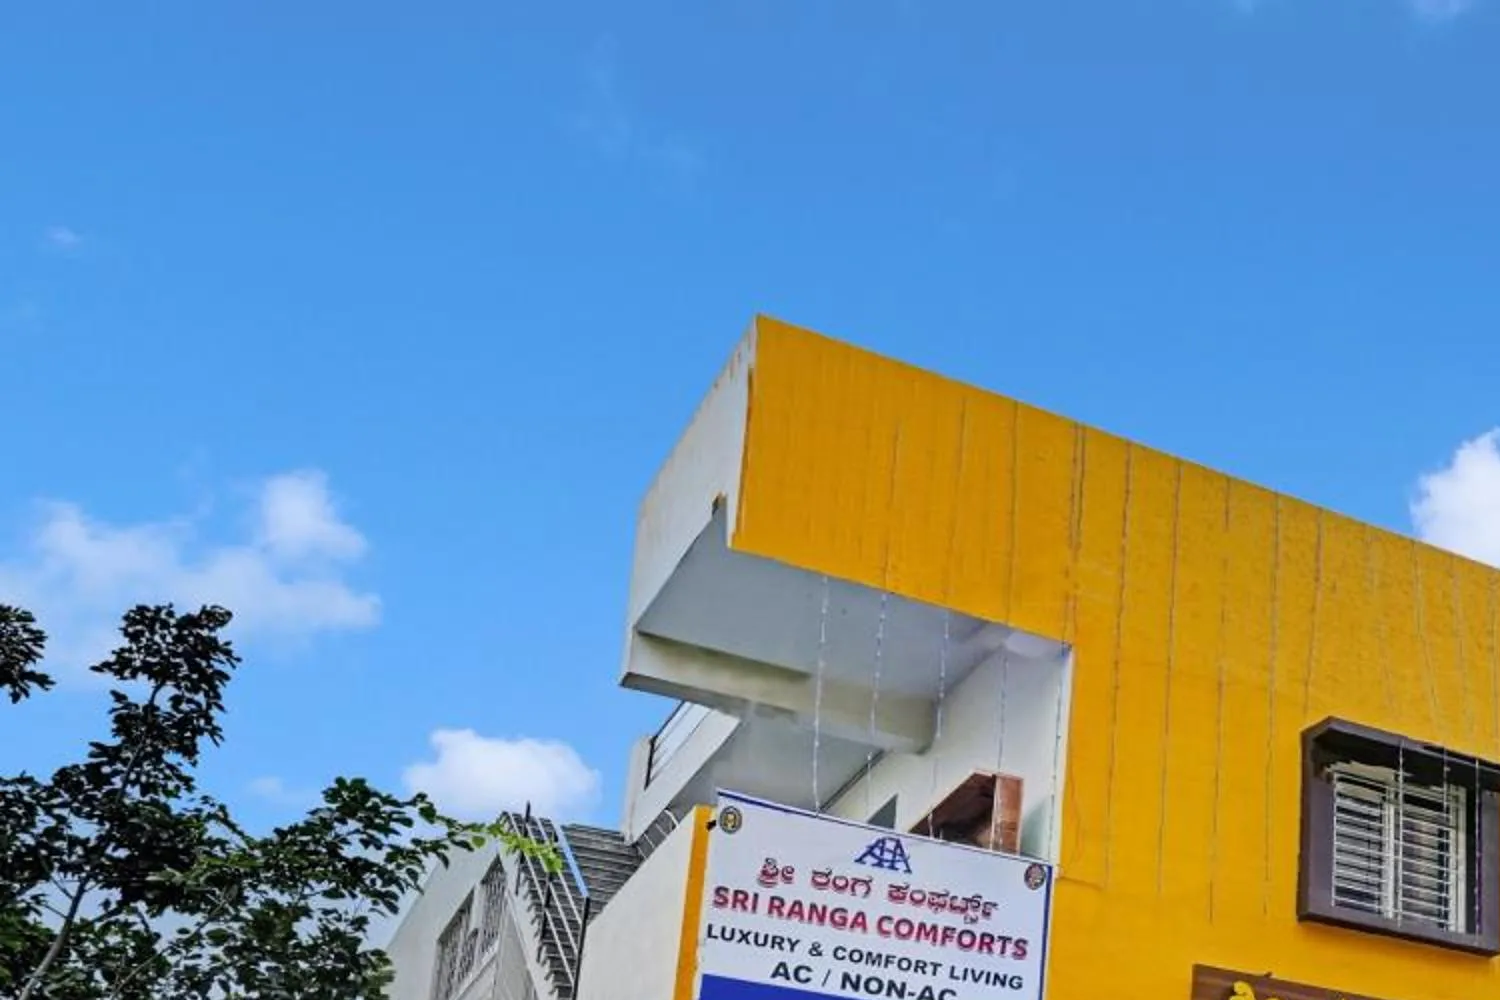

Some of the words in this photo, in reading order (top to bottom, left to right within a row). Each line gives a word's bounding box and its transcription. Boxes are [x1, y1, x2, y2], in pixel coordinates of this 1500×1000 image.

[757, 857, 796, 888] ಶ್ರೀ
[811, 867, 874, 898] ರಂಗ
[712, 886, 758, 915] SRI
[767, 894, 868, 936] RANGA
[876, 914, 1029, 961] COMFORTS
[706, 923, 801, 956] LUXURY
[807, 940, 824, 958] &
[832, 945, 943, 978] COMFORT
[949, 964, 1024, 991] LIVING
[770, 960, 813, 985] AC
